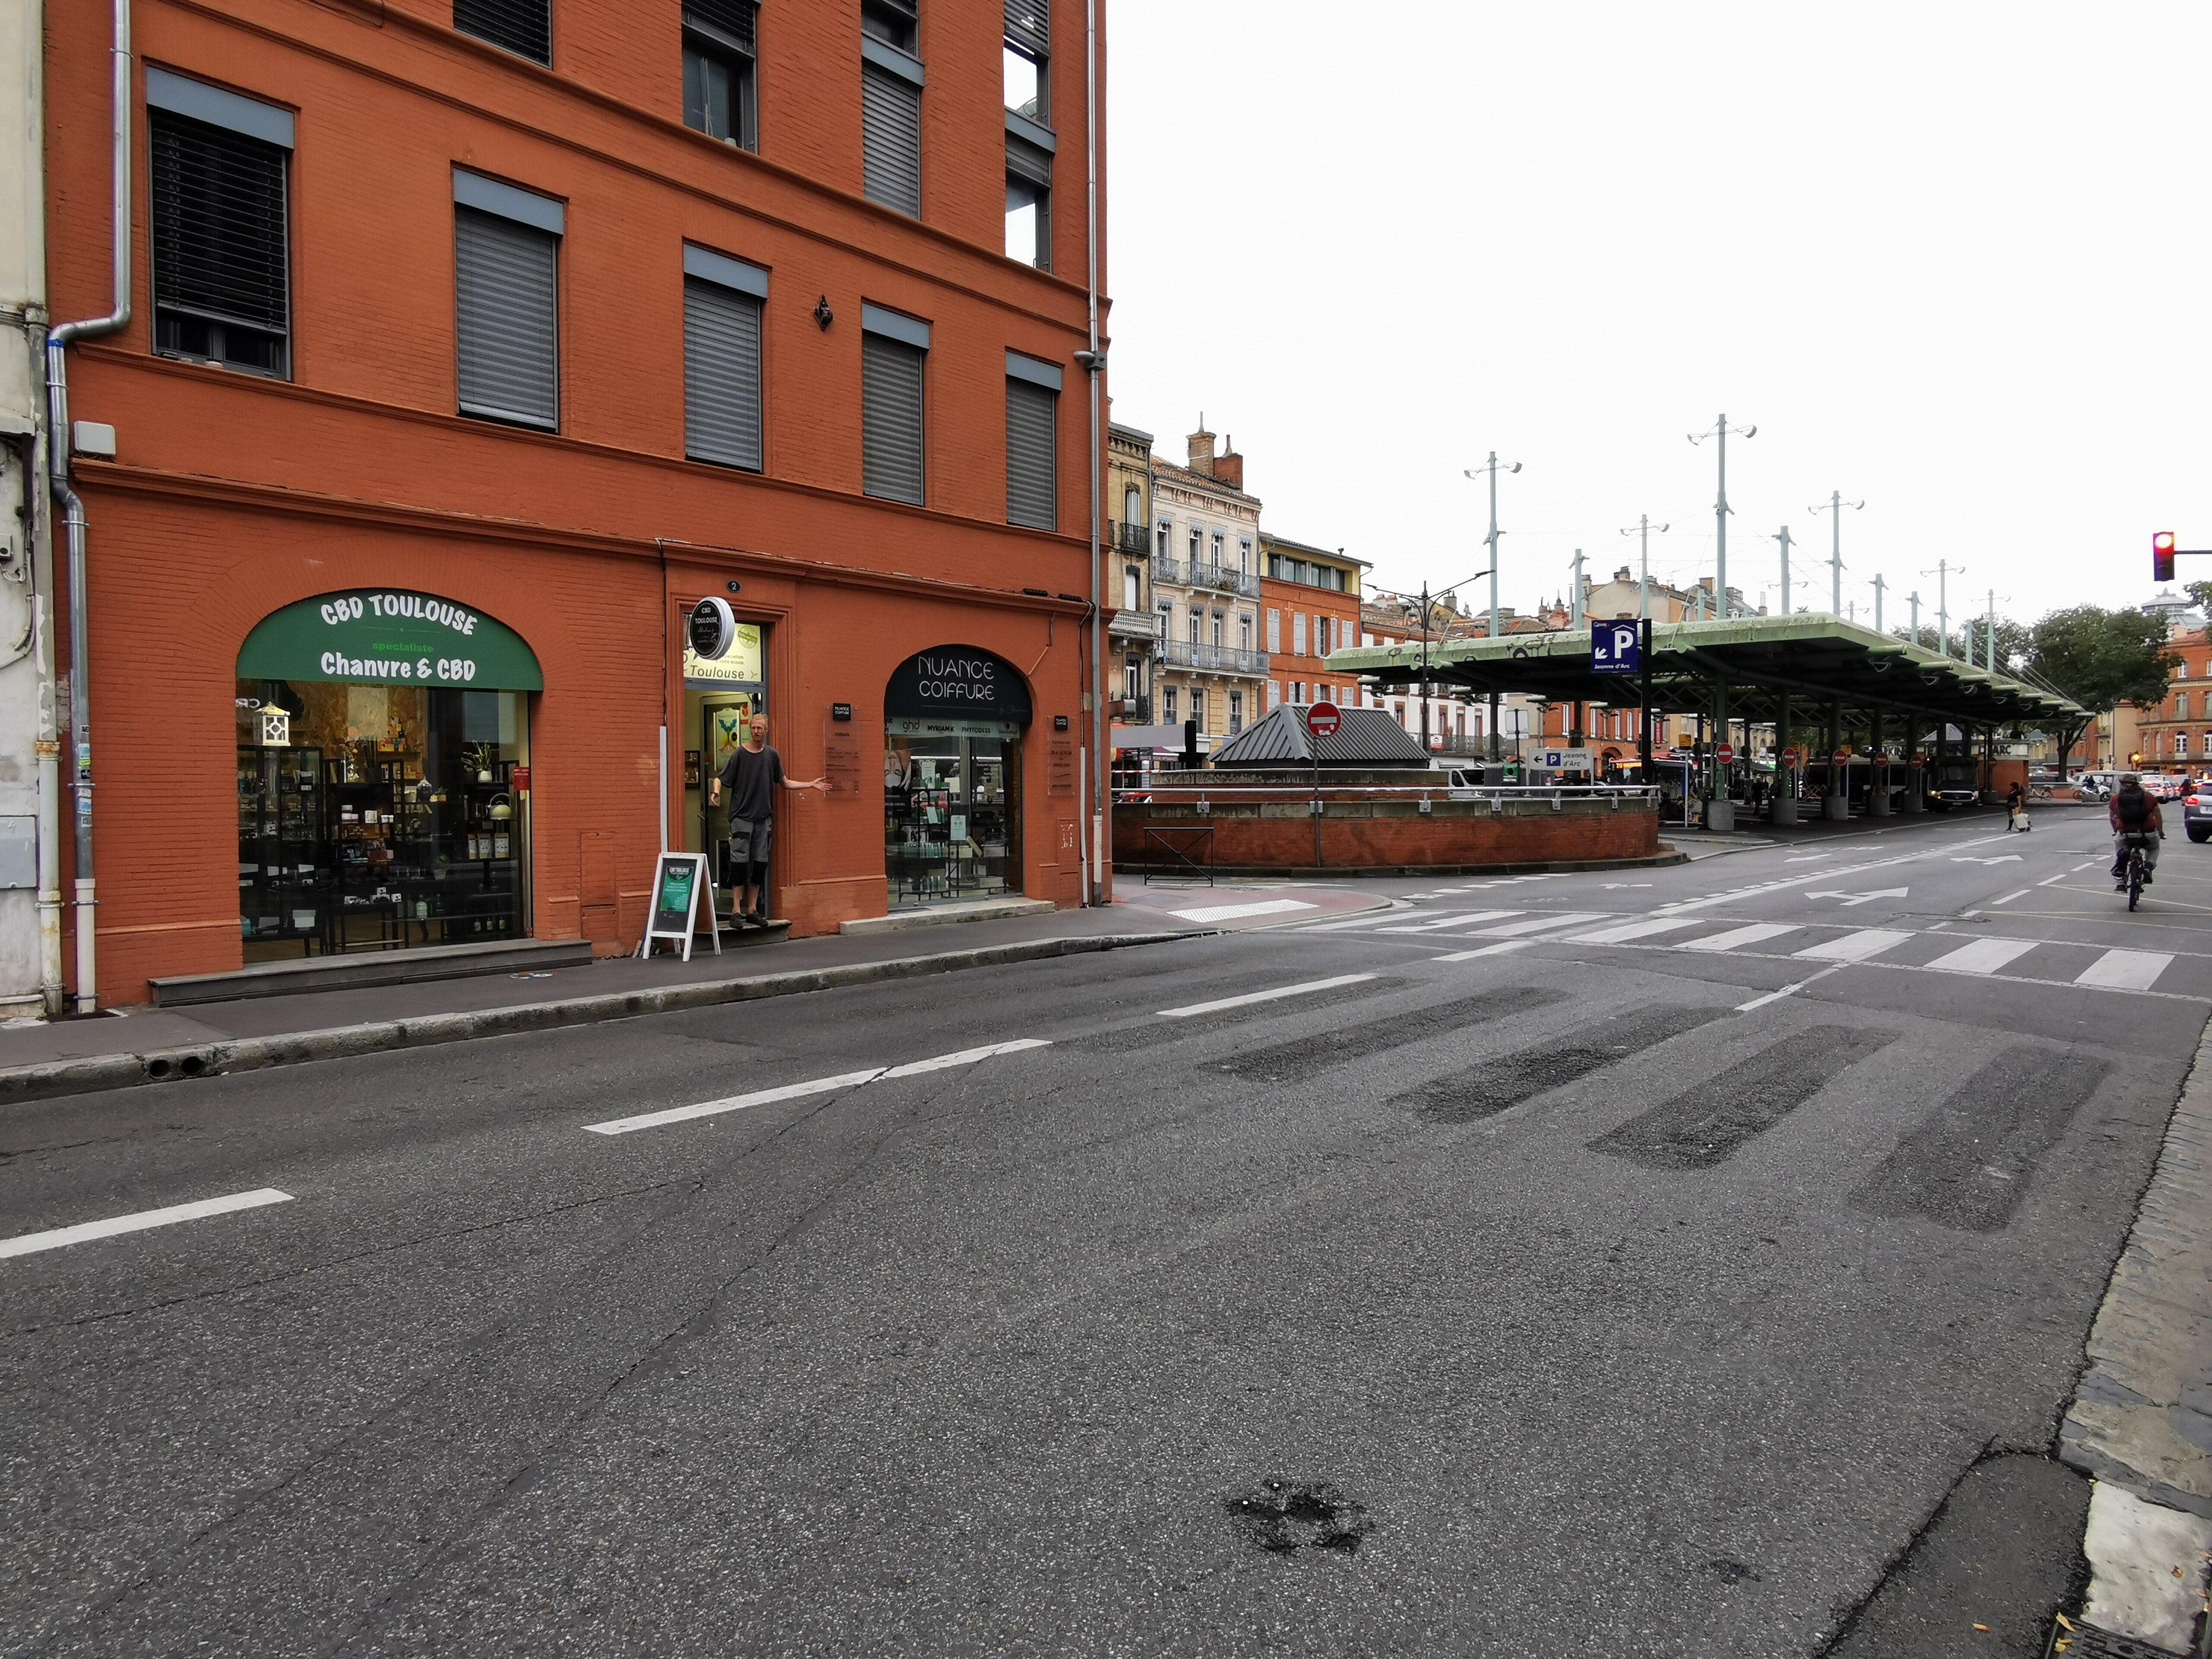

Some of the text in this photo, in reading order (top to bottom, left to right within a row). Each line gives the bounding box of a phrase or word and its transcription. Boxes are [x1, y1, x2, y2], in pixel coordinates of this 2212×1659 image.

[731, 582, 737, 591] 2
[321, 594, 477, 635] CBD TOULOUSE
[372, 642, 434, 653] spécialiste
[1615, 631, 1633, 658] P
[321, 652, 476, 681] Chanvre & CBD
[690, 665, 744, 679] Toulouse
[919, 656, 994, 680] NUANCE
[919, 680, 995, 700] COIFFURE
[903, 719, 920, 732] ghd
[1550, 755, 1557, 764] P
